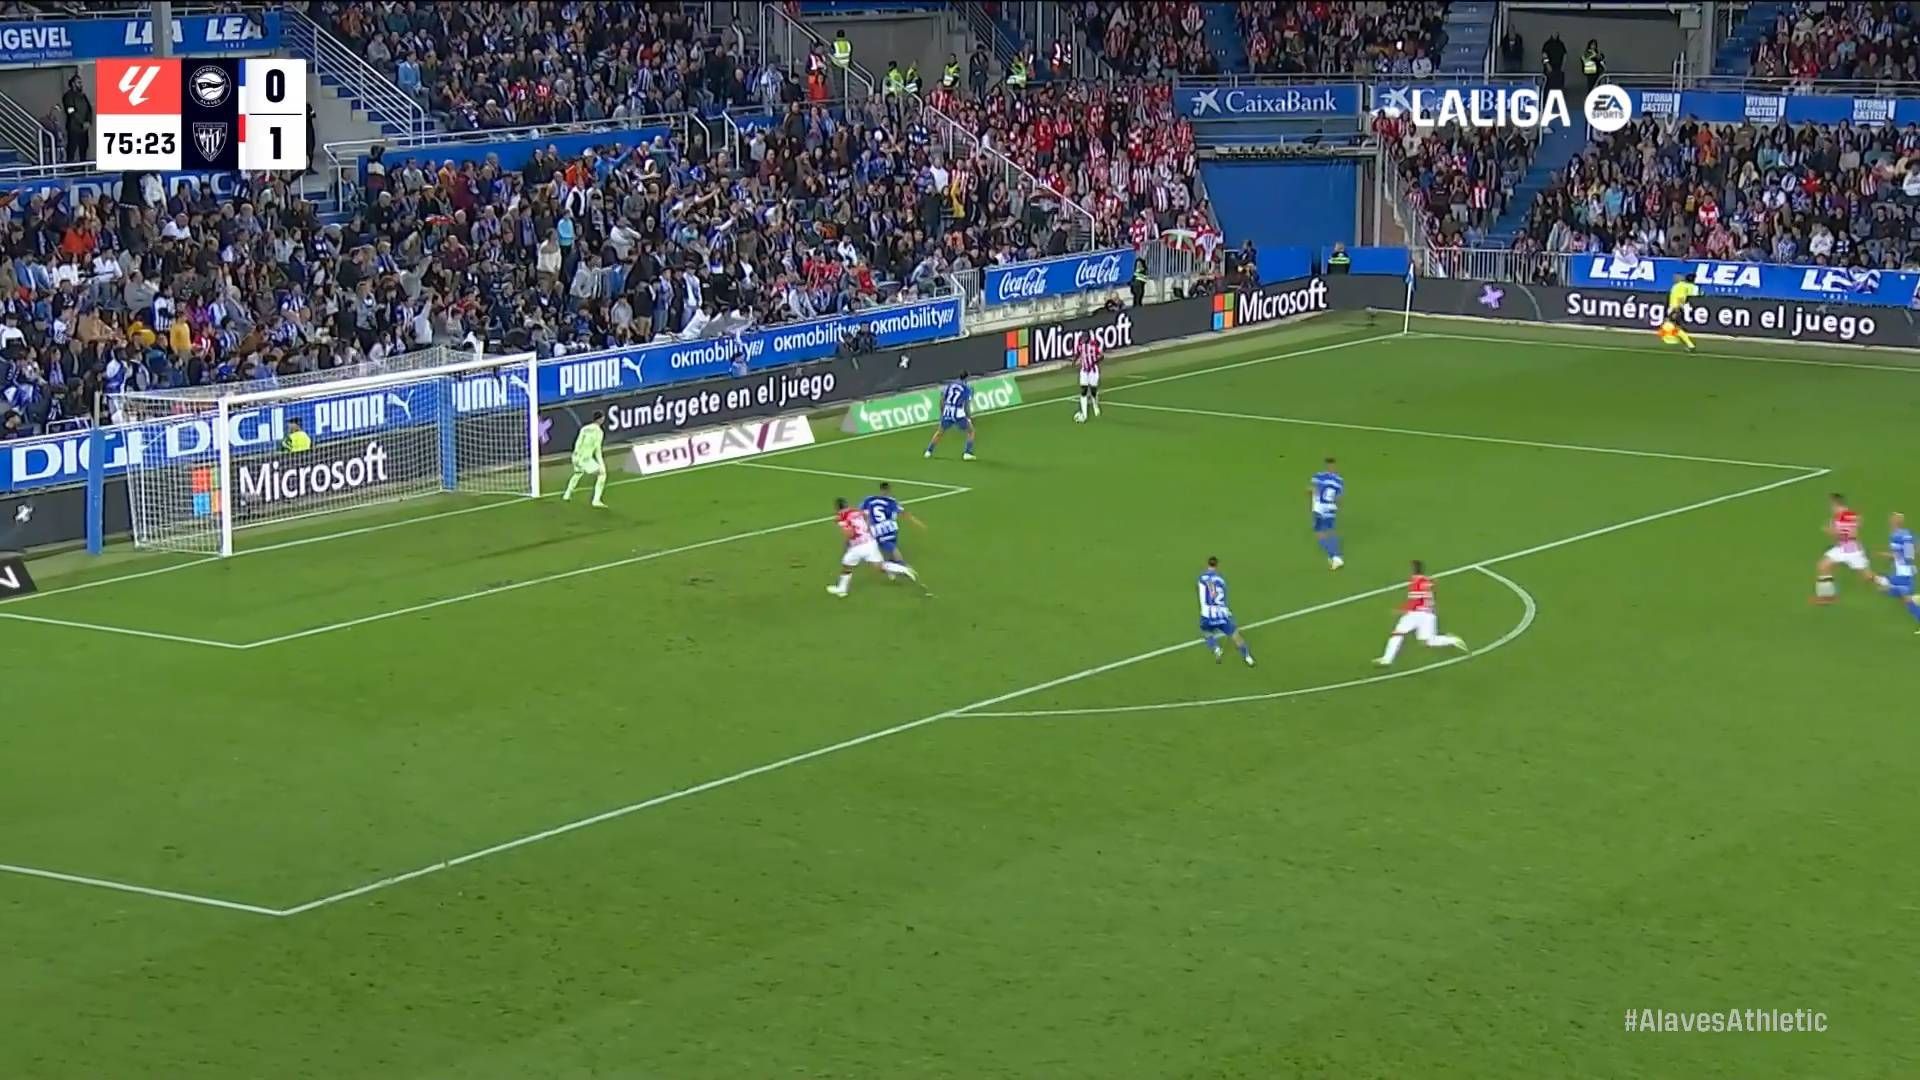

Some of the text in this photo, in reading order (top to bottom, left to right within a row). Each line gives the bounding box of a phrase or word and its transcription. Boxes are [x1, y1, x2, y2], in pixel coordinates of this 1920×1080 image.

[0, 27, 72, 50] GEVEL
[206, 17, 263, 42] LEA
[1225, 89, 1337, 113] CaixaBank
[1589, 256, 1656, 282] LEA
[1694, 263, 1761, 289] LEA
[1238, 277, 1328, 325] Microsoft
[1566, 293, 1876, 340] Sumérgte en el juego
[1034, 313, 1132, 362] Micrsoft
[451, 374, 508, 413] UMA
[559, 357, 621, 397] PUMA
[314, 393, 385, 436] PUMA
[608, 372, 836, 432] Sumérgete en el juego
[645, 413, 801, 466] renfe AVE
[239, 440, 389, 503] Microsoft
